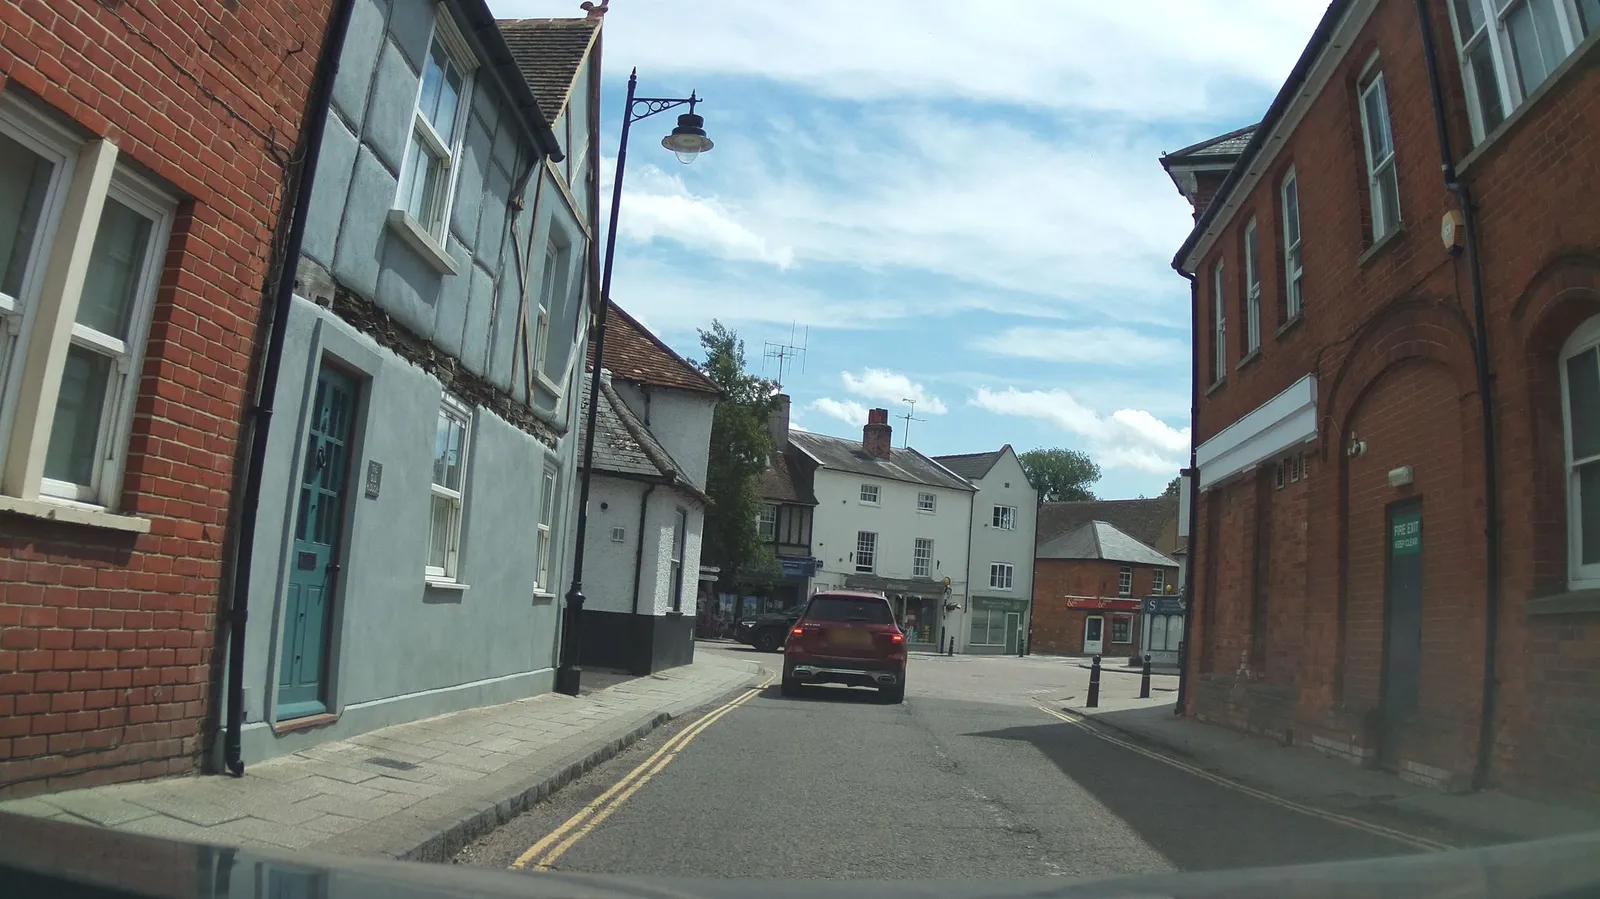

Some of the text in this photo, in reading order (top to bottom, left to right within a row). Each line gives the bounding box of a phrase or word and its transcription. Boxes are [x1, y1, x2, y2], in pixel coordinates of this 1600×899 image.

[1394, 520, 1419, 537] FIRE EXIT
[1394, 537, 1418, 549] KEEP CLEAR
